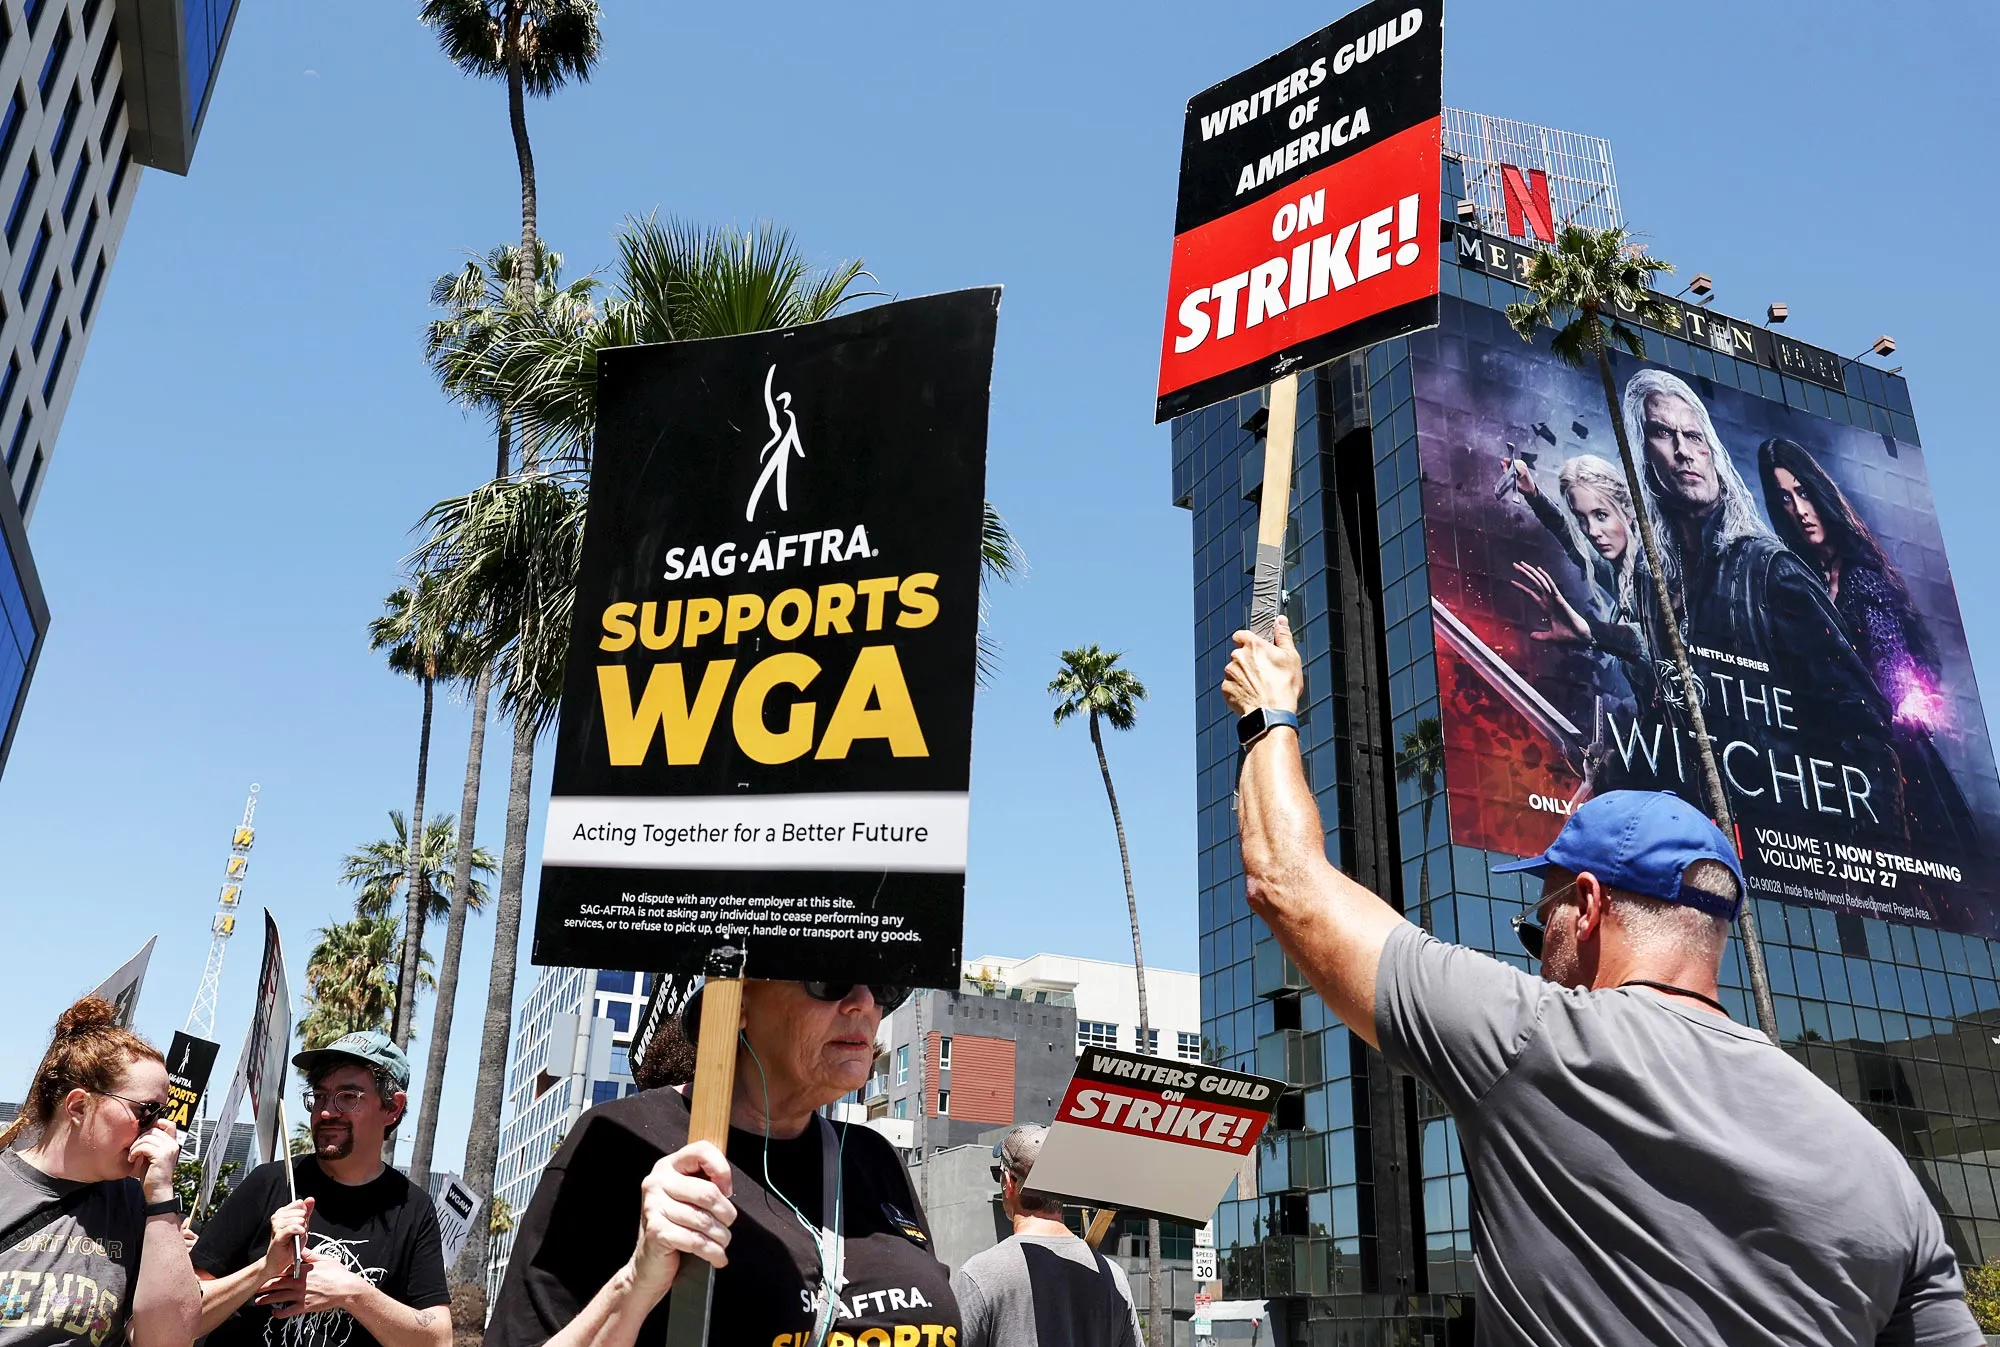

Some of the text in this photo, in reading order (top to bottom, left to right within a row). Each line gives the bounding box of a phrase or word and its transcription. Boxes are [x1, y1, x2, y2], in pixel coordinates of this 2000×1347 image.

[1200, 8, 1423, 142] WRITERS GUILD
[1288, 96, 1320, 130] OF
[1235, 106, 1371, 197] AMERICA
[1271, 188, 1326, 242] ON
[1174, 192, 1421, 355] STRIKE!
[599, 572, 940, 652] SUPPORTS
[1689, 644, 1770, 673] A NETFLIX SERIES
[596, 644, 930, 767] WGA
[1711, 672, 1798, 730] THE
[1528, 793, 1574, 815] ONLY
[573, 822, 929, 847] Acting Together for a Better Future
[1755, 827, 1962, 883] VOLUME 1 NOW STREAMING
[1758, 847, 1898, 888] VOLUME 2 JULY 27
[580, 904, 904, 928] SAG-AFTRA is not asking any individual to cease performing any
[621, 892, 856, 909] No dispute with any other employer at this site.
[1750, 876, 1761, 891] CA
[1783, 882, 1803, 898] Inside
[1803, 886, 1814, 900] the
[1814, 888, 1845, 906] Hollywood
[1845, 893, 1893, 914] Redevelopment
[1893, 902, 1915, 919] Project
[1915, 906, 1932, 921] Area.
[564, 918, 922, 943] services, or to refuse to pick up, deliver, handle or transport any goods.
[634, 973, 673, 1066] WRITERS
[667, 986, 678, 1015] OF
[1092, 1054, 1270, 1101] WRITERS GUILD
[1161, 1089, 1186, 1103] ON
[1069, 1089, 1253, 1149] STRIKE!
[67, 1236, 123, 1259] YOUR
[1196, 1266, 1213, 1278] 30
